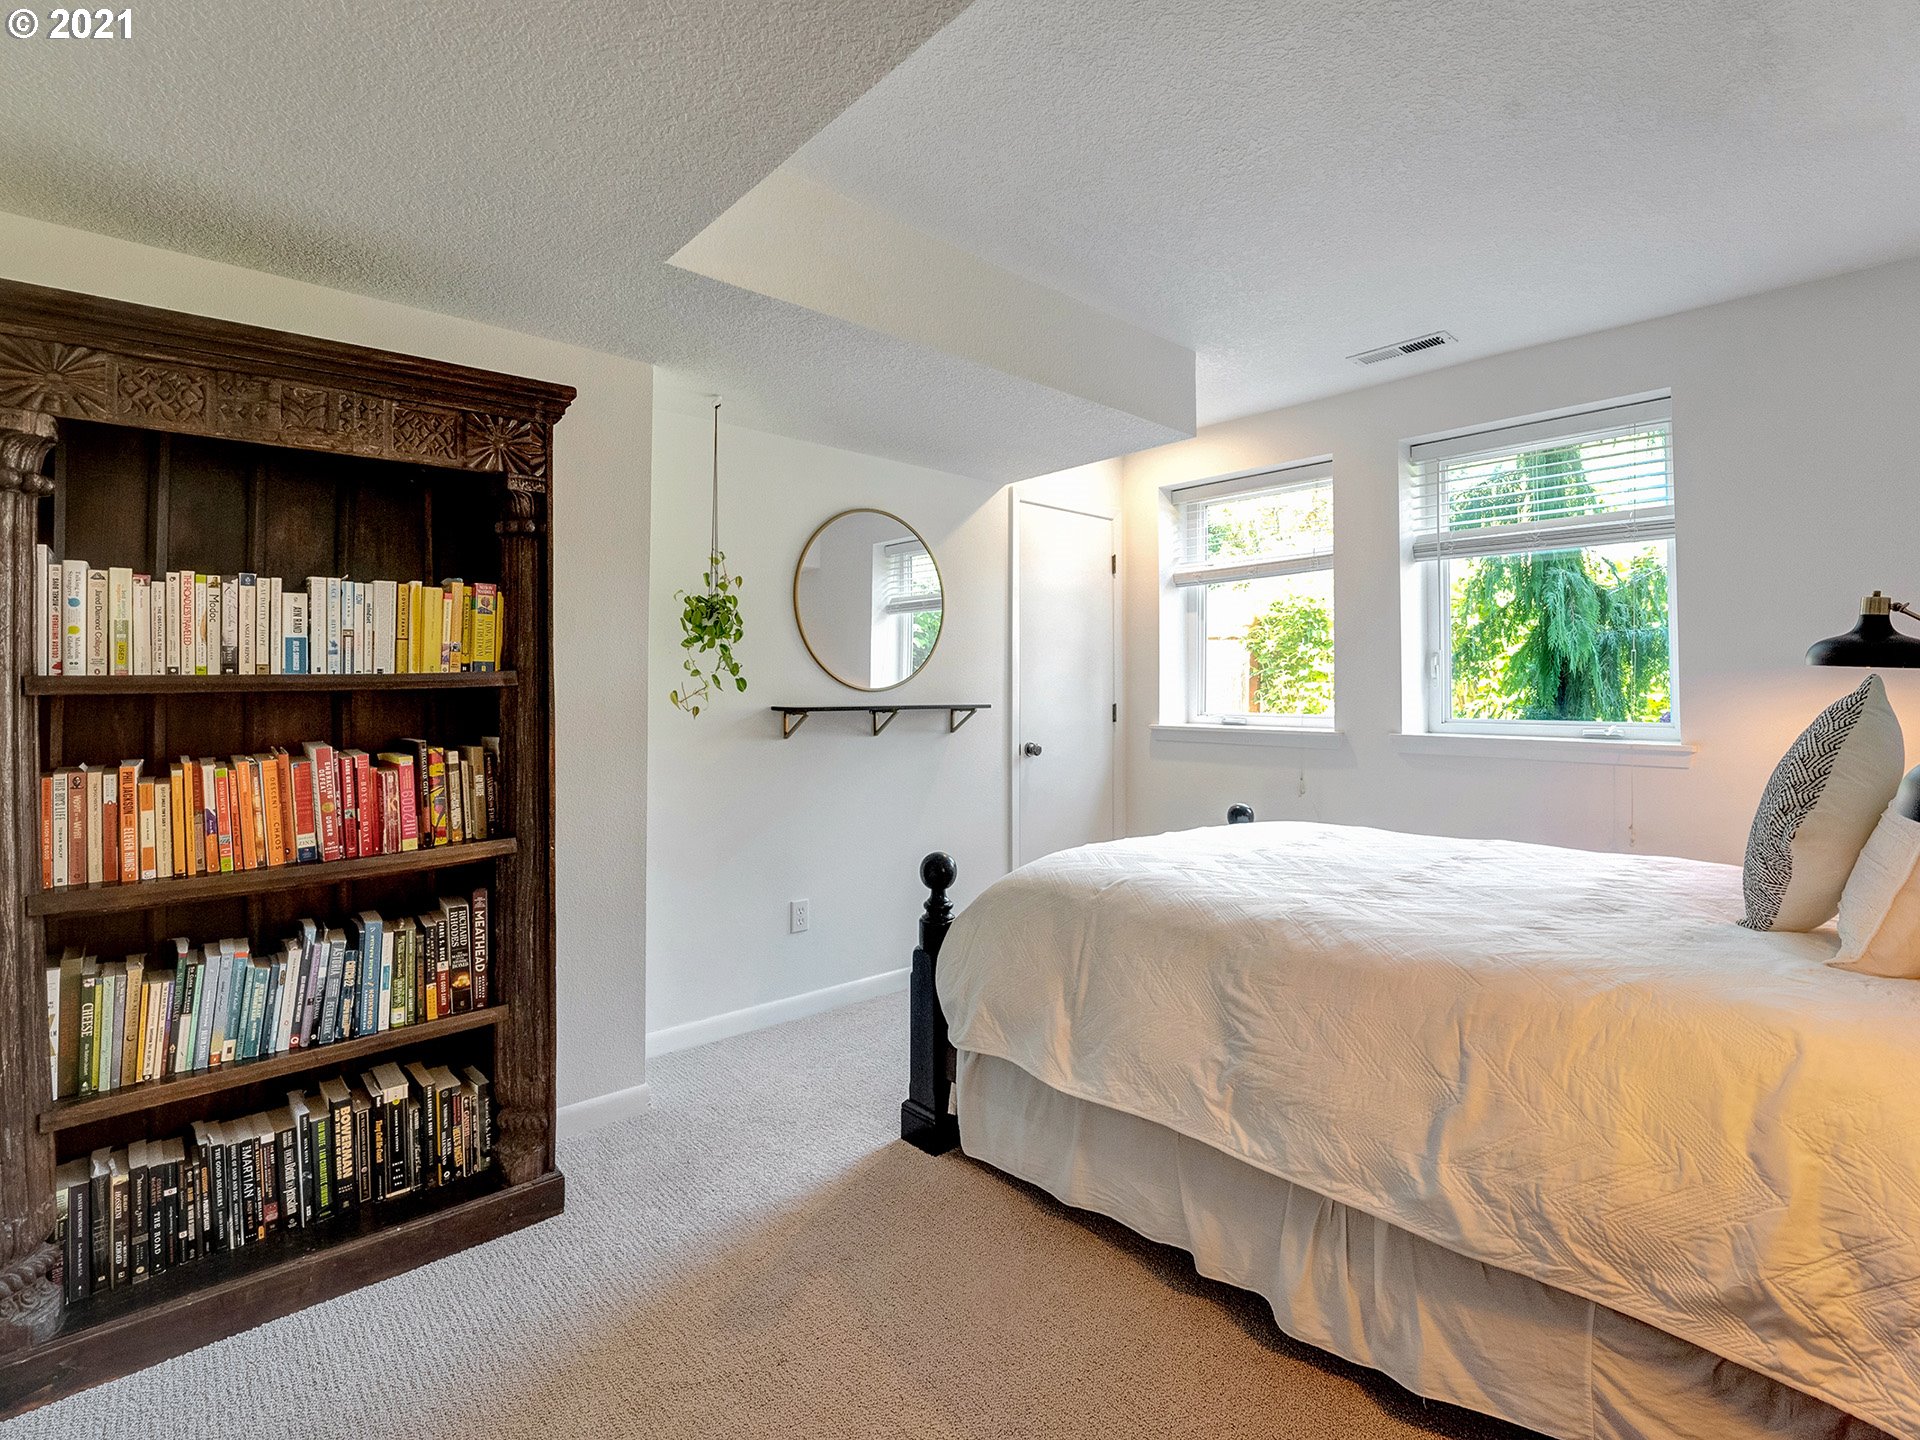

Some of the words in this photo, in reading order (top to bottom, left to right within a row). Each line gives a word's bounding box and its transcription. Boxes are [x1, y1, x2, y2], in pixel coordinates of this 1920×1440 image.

[209, 594, 219, 622] Modoc
[293, 606, 302, 617] AYN
[183, 616, 192, 645] TRAVELED
[293, 618, 302, 633] RAND
[484, 620, 493, 636] LONG
[476, 628, 484, 656] FREEDOM
[484, 639, 493, 655] WALK
[55, 778, 65, 791] THIS
[122, 771, 132, 785] PHIL
[324, 761, 333, 799] EMBRACING
[123, 787, 133, 815] JACKSON
[55, 808, 65, 820] LIFE
[270, 777, 278, 809] DESCENT
[274, 822, 282, 850] CHAOS
[124, 828, 134, 851] ELEVEN
[124, 852, 135, 872] RINGS
[450, 912, 460, 948] RHODES
[458, 910, 468, 946] RICHARD
[475, 910, 485, 972] MEATHEAD
[330, 948, 343, 975] ASTORIA
[176, 972, 182, 983] NO
[173, 985, 182, 1023] BOUNDARY
[325, 1001, 334, 1017] PETER
[81, 1003, 94, 1038] CHEESE
[323, 1018, 333, 1035] STARK
[374, 1120, 382, 1132] They
[486, 1118, 490, 1126] C.
[318, 1132, 326, 1147] WOLFE
[340, 1106, 352, 1178] BOWERMAN
[453, 1127, 461, 1146] HELL'S
[284, 1149, 293, 1164] FROM
[454, 1146, 462, 1167] ANGELS
[242, 1150, 254, 1198] MARTIAN
[285, 1163, 296, 1180] Beirut
[283, 1188, 297, 1215] Jerusalem
